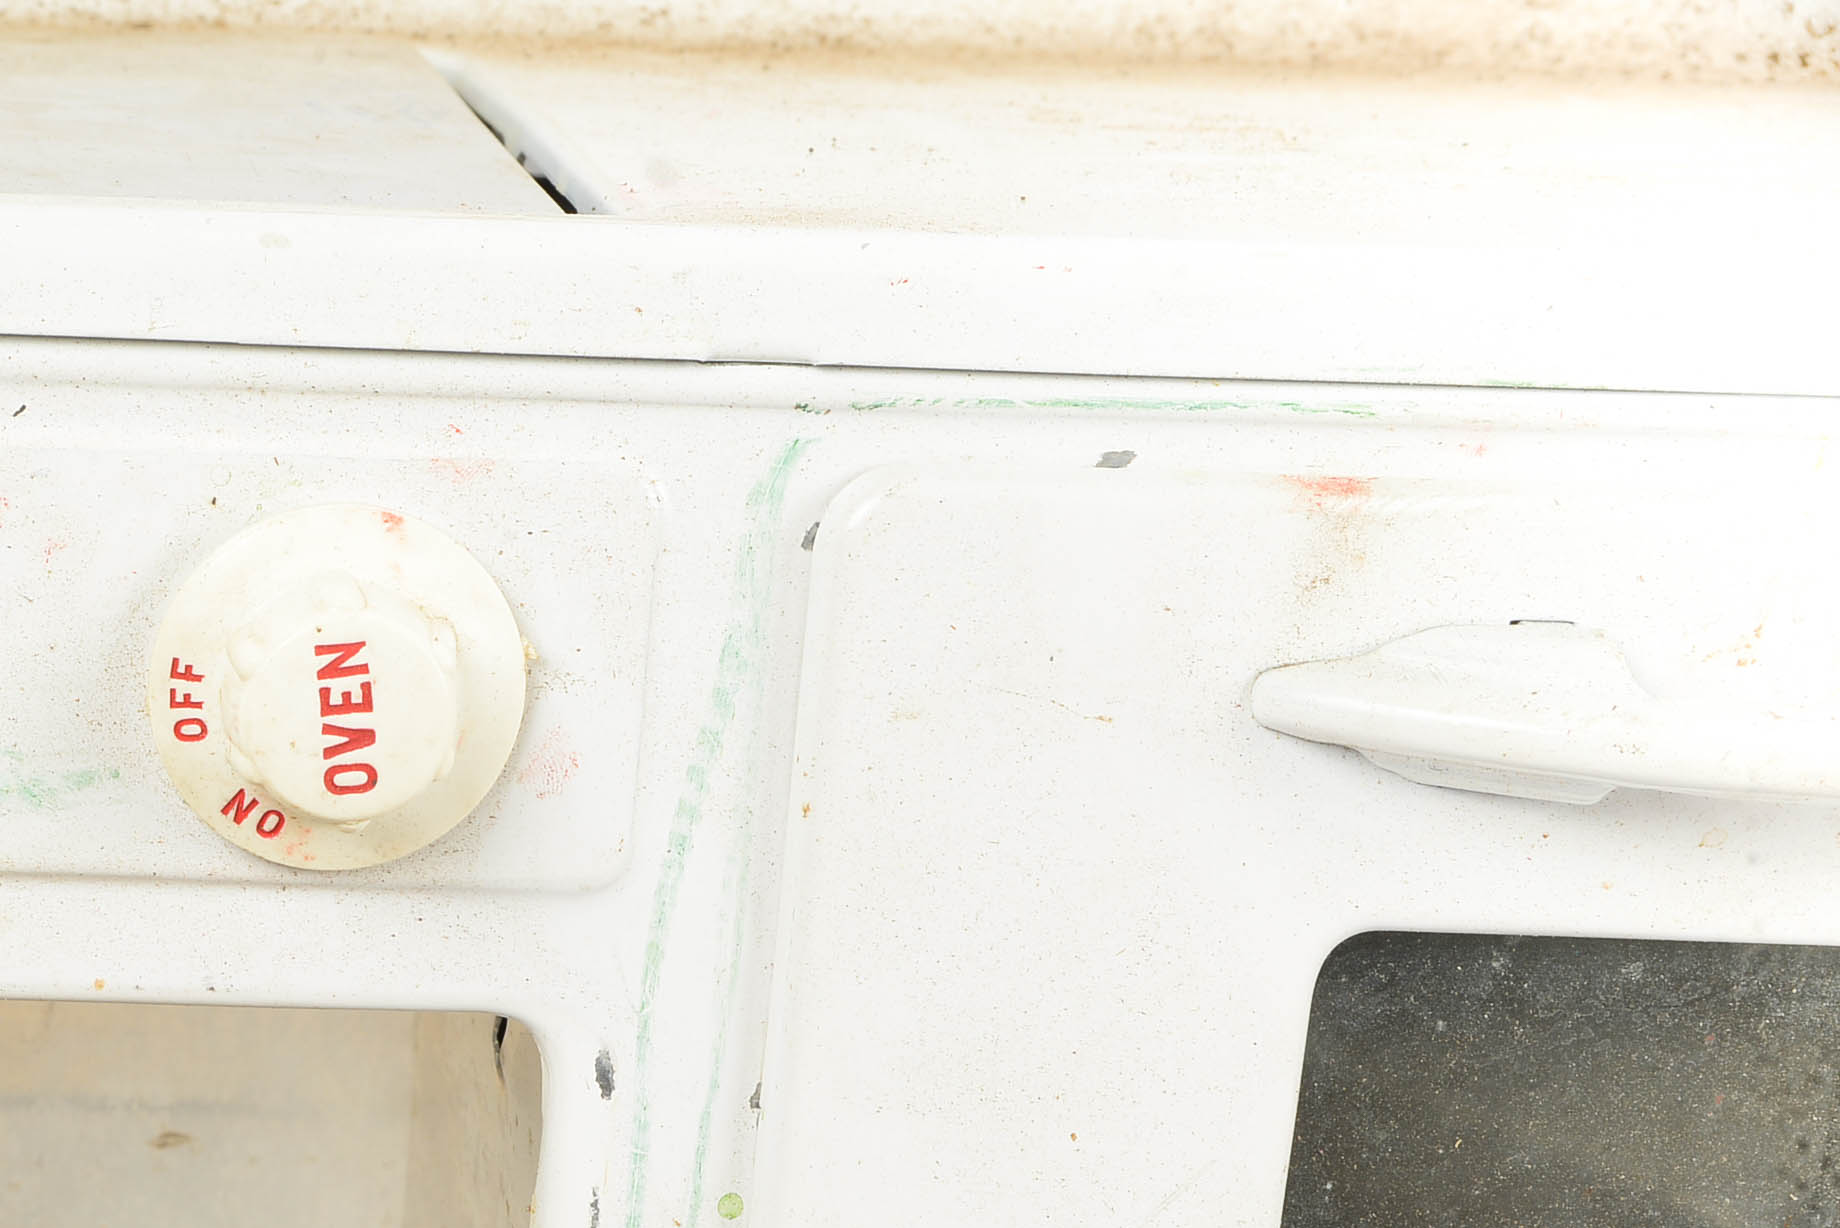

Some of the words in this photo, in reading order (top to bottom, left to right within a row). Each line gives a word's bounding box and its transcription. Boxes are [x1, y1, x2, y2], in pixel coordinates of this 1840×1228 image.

[169, 657, 209, 743] OFF
[314, 640, 379, 796] OVEN
[220, 788, 287, 840] ON
